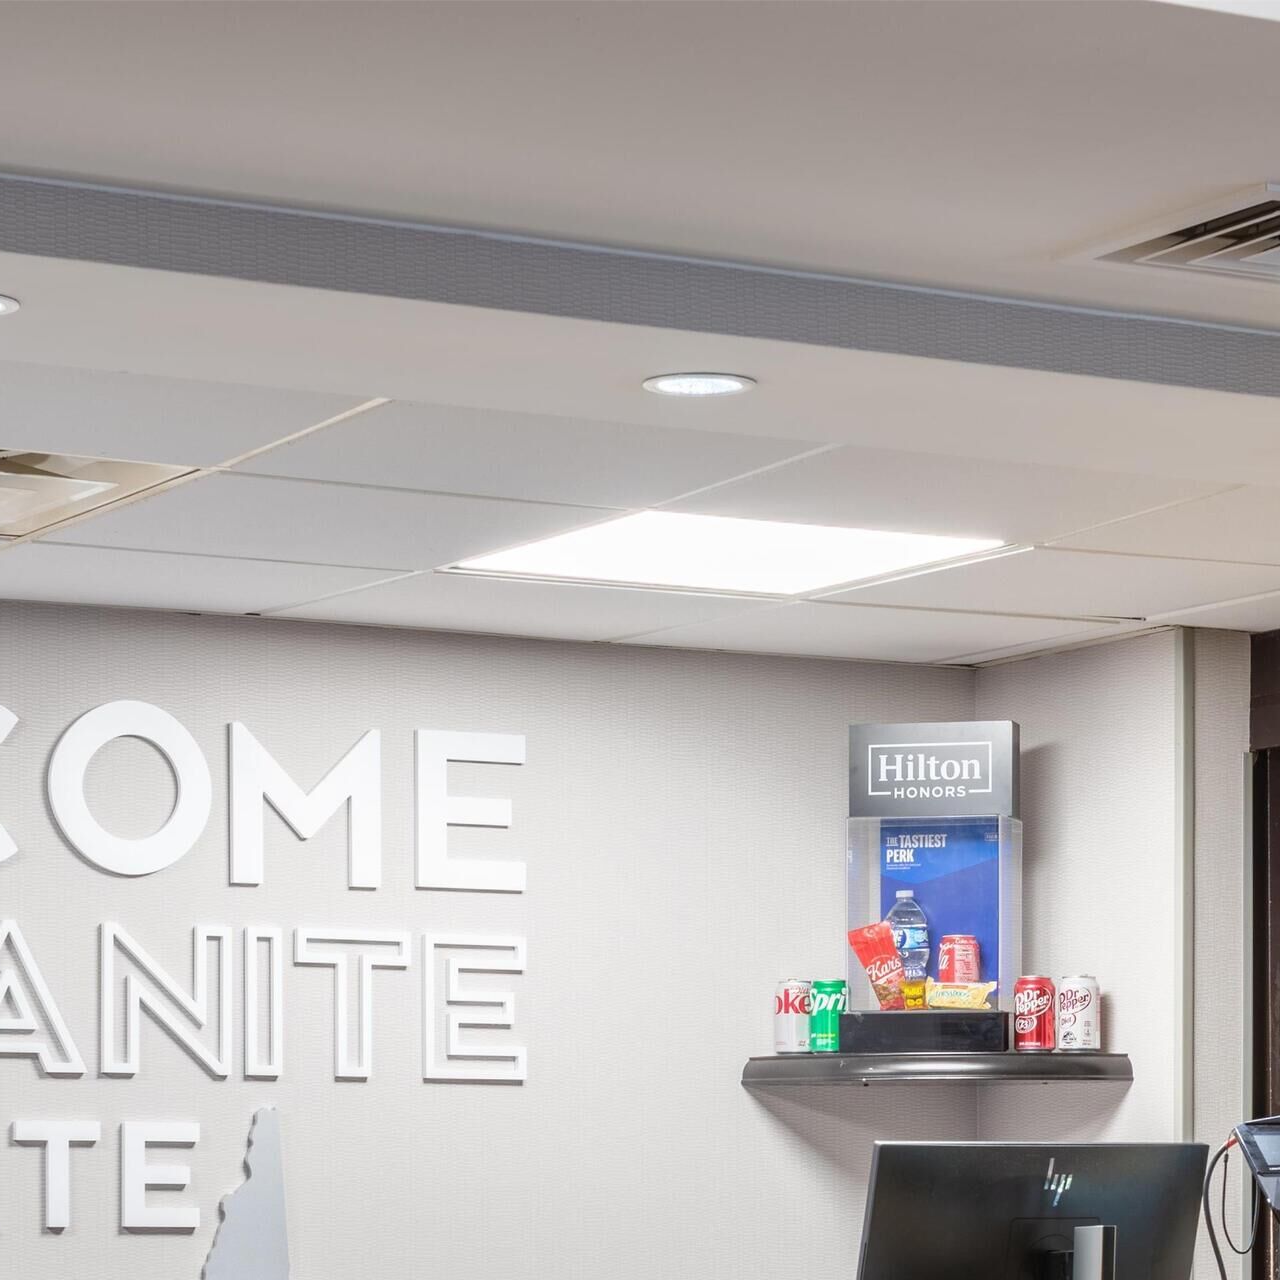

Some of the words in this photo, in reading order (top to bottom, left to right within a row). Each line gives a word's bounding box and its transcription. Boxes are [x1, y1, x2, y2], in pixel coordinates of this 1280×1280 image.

[878, 753, 982, 782] Hilton
[893, 785, 967, 799] HONORS
[898, 833, 948, 849] TASTIEST
[885, 848, 915, 863] PERK
[1024, 989, 1040, 1000] Dr
[1066, 989, 1080, 998] Dr
[1015, 993, 1050, 1015] Pepper
